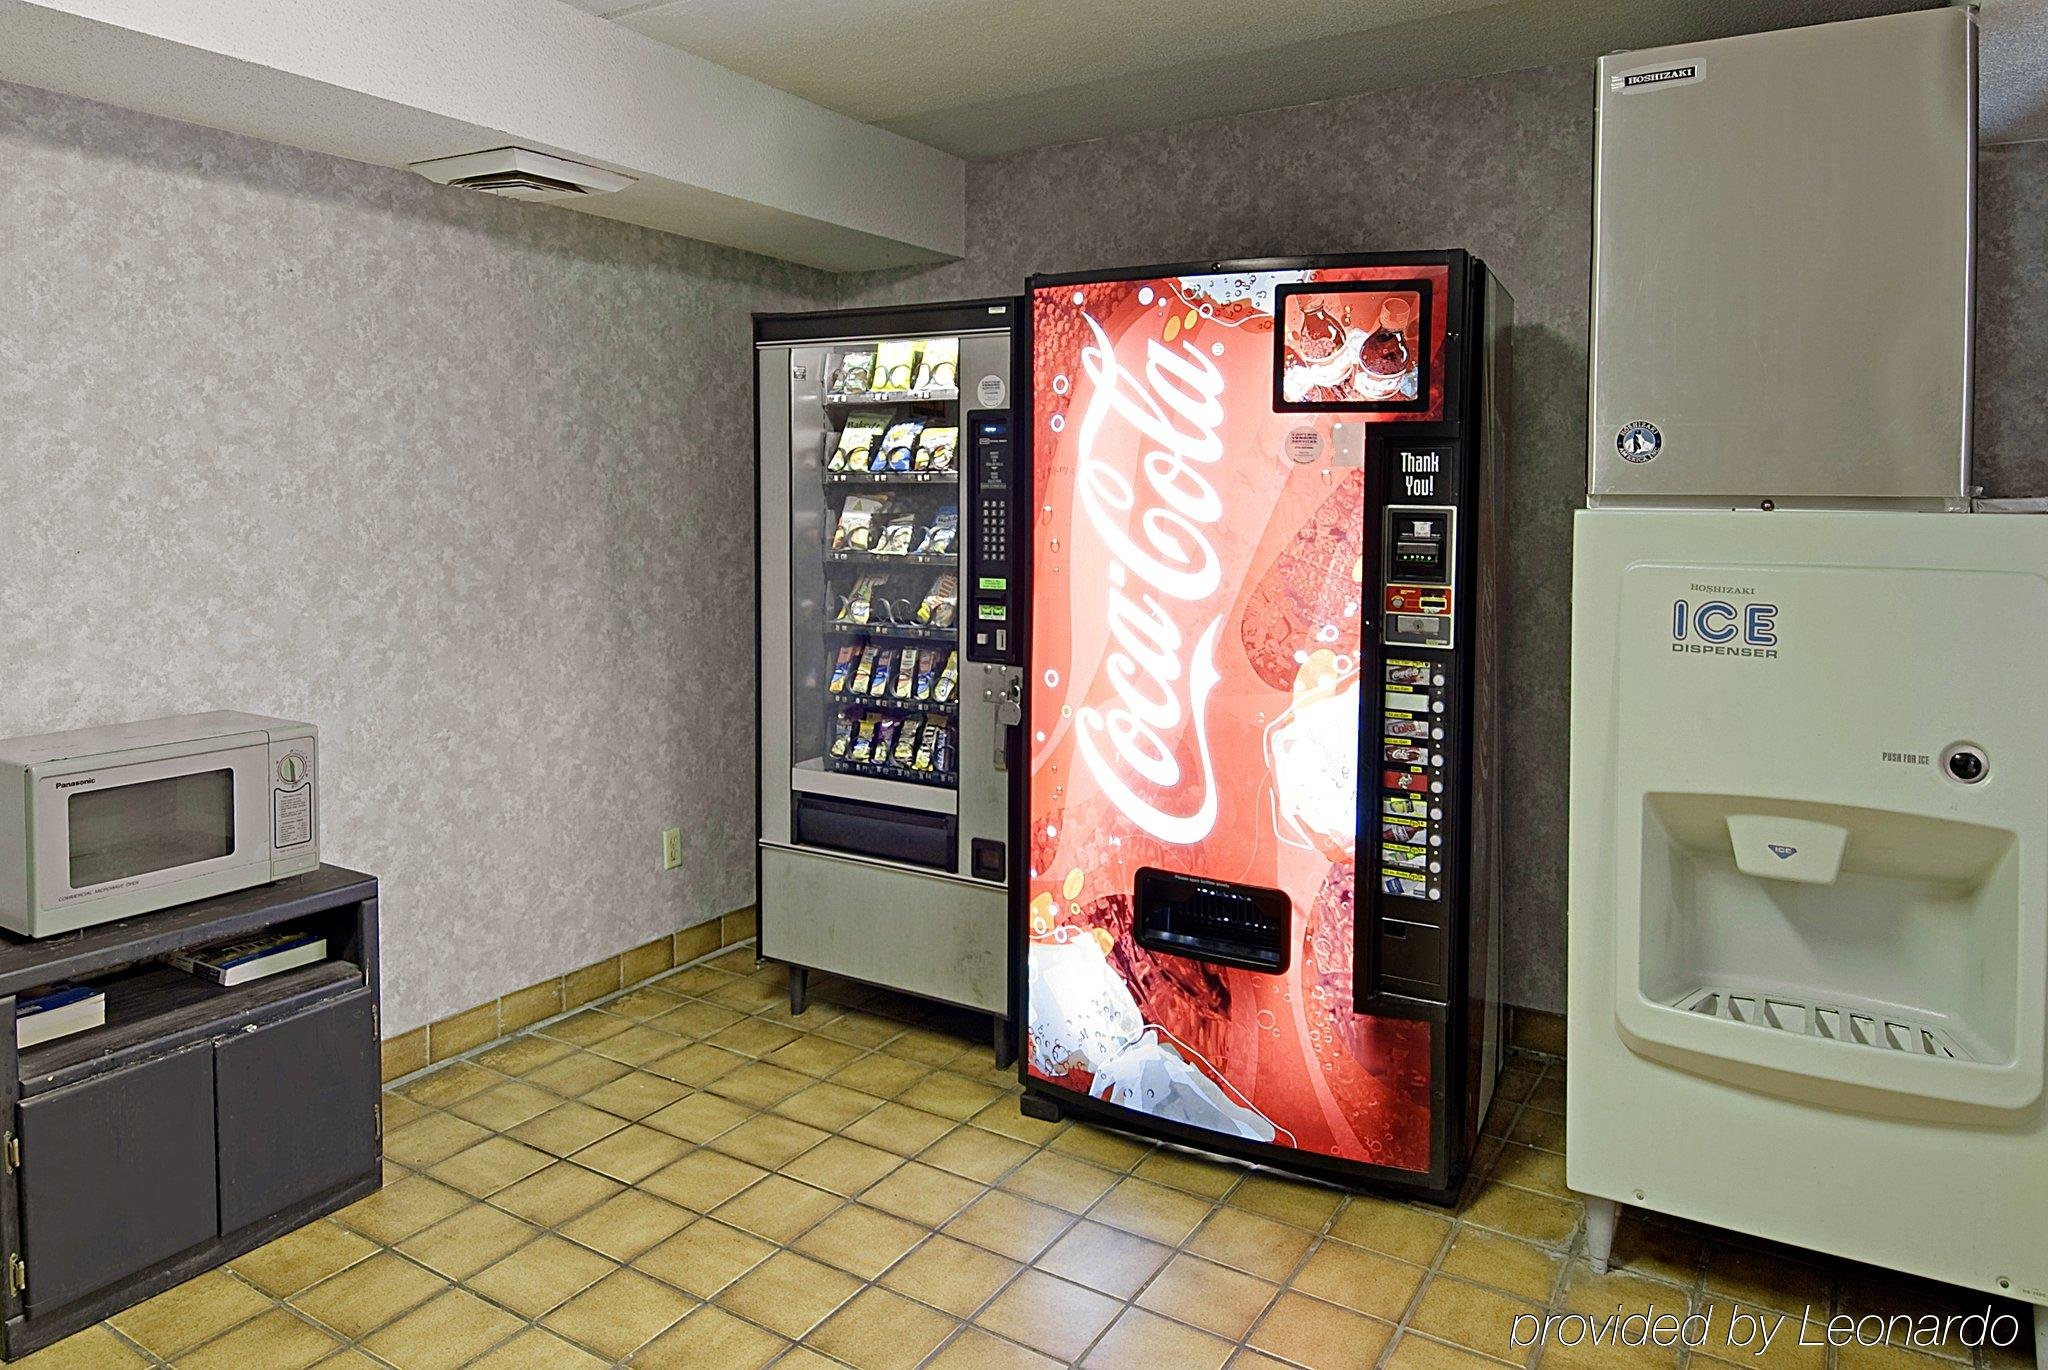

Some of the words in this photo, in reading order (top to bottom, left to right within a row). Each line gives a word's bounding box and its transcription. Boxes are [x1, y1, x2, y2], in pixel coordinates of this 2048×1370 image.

[1627, 68, 1693, 85] HOSHIZAKI
[1400, 452, 1439, 473] Thank
[1405, 475, 1434, 496] You!
[1690, 583, 1756, 595] HOSHIZAKI
[1673, 599, 1778, 646] ICE
[1672, 643, 1778, 659] DISPENSER
[1882, 752, 1902, 762] PUSH
[1903, 753, 1917, 763] FOR
[1918, 755, 1930, 765] ICE
[55, 777, 96, 790] Panasonic
